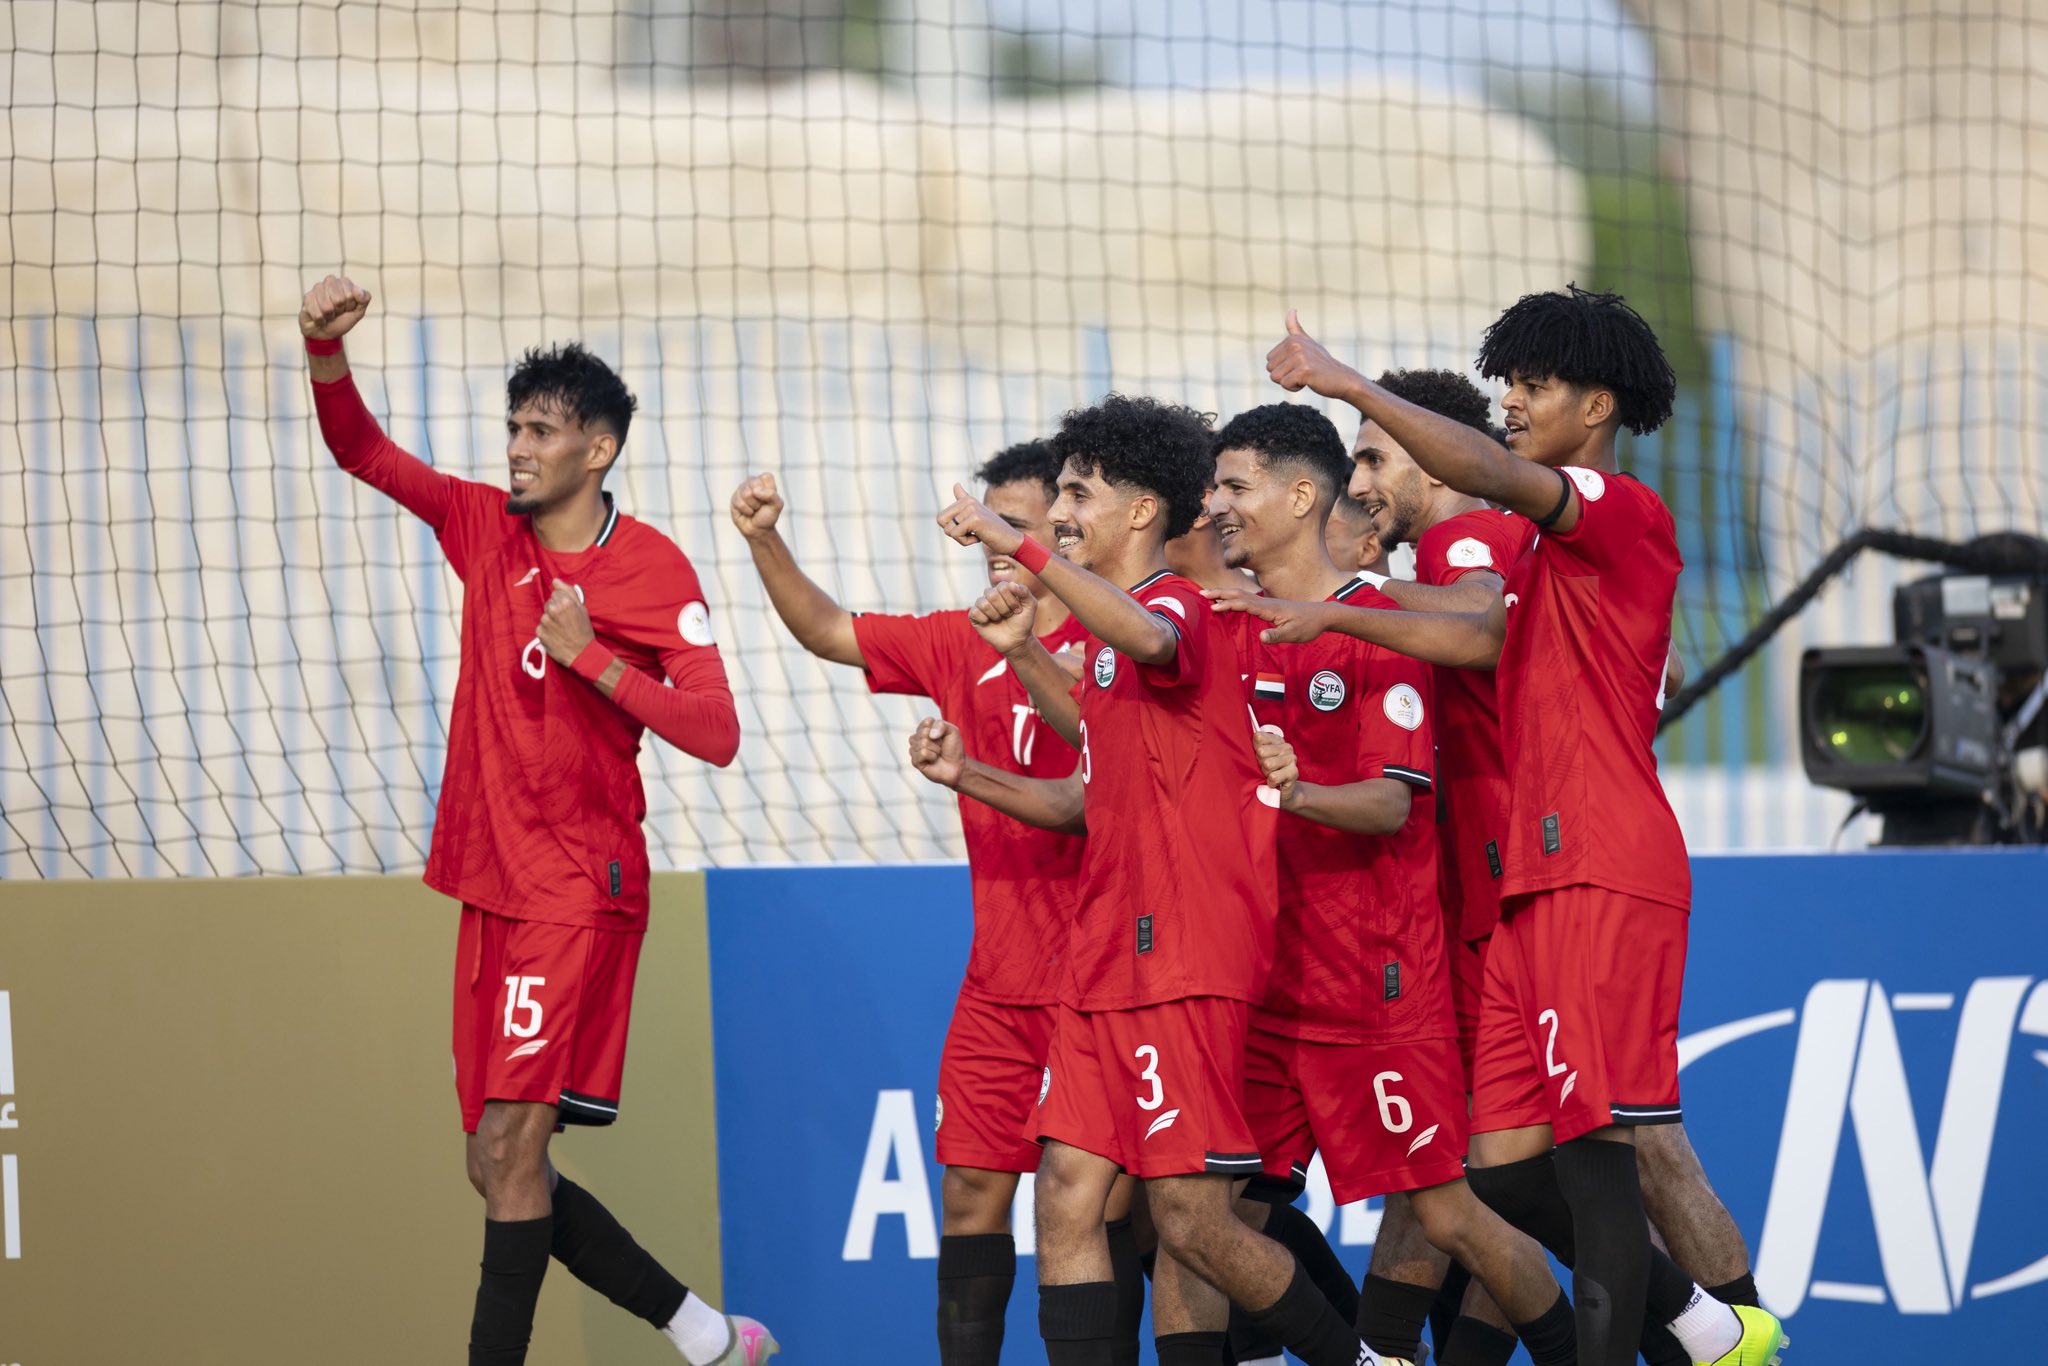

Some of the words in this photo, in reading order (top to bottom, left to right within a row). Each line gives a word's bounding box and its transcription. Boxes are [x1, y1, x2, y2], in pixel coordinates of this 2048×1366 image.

[1324, 684, 1341, 693] YFA
[503, 976, 545, 1037] 15
[1538, 1008, 1567, 1077] 2
[1135, 1044, 1164, 1110] 3
[1373, 1071, 1413, 1133] 6
